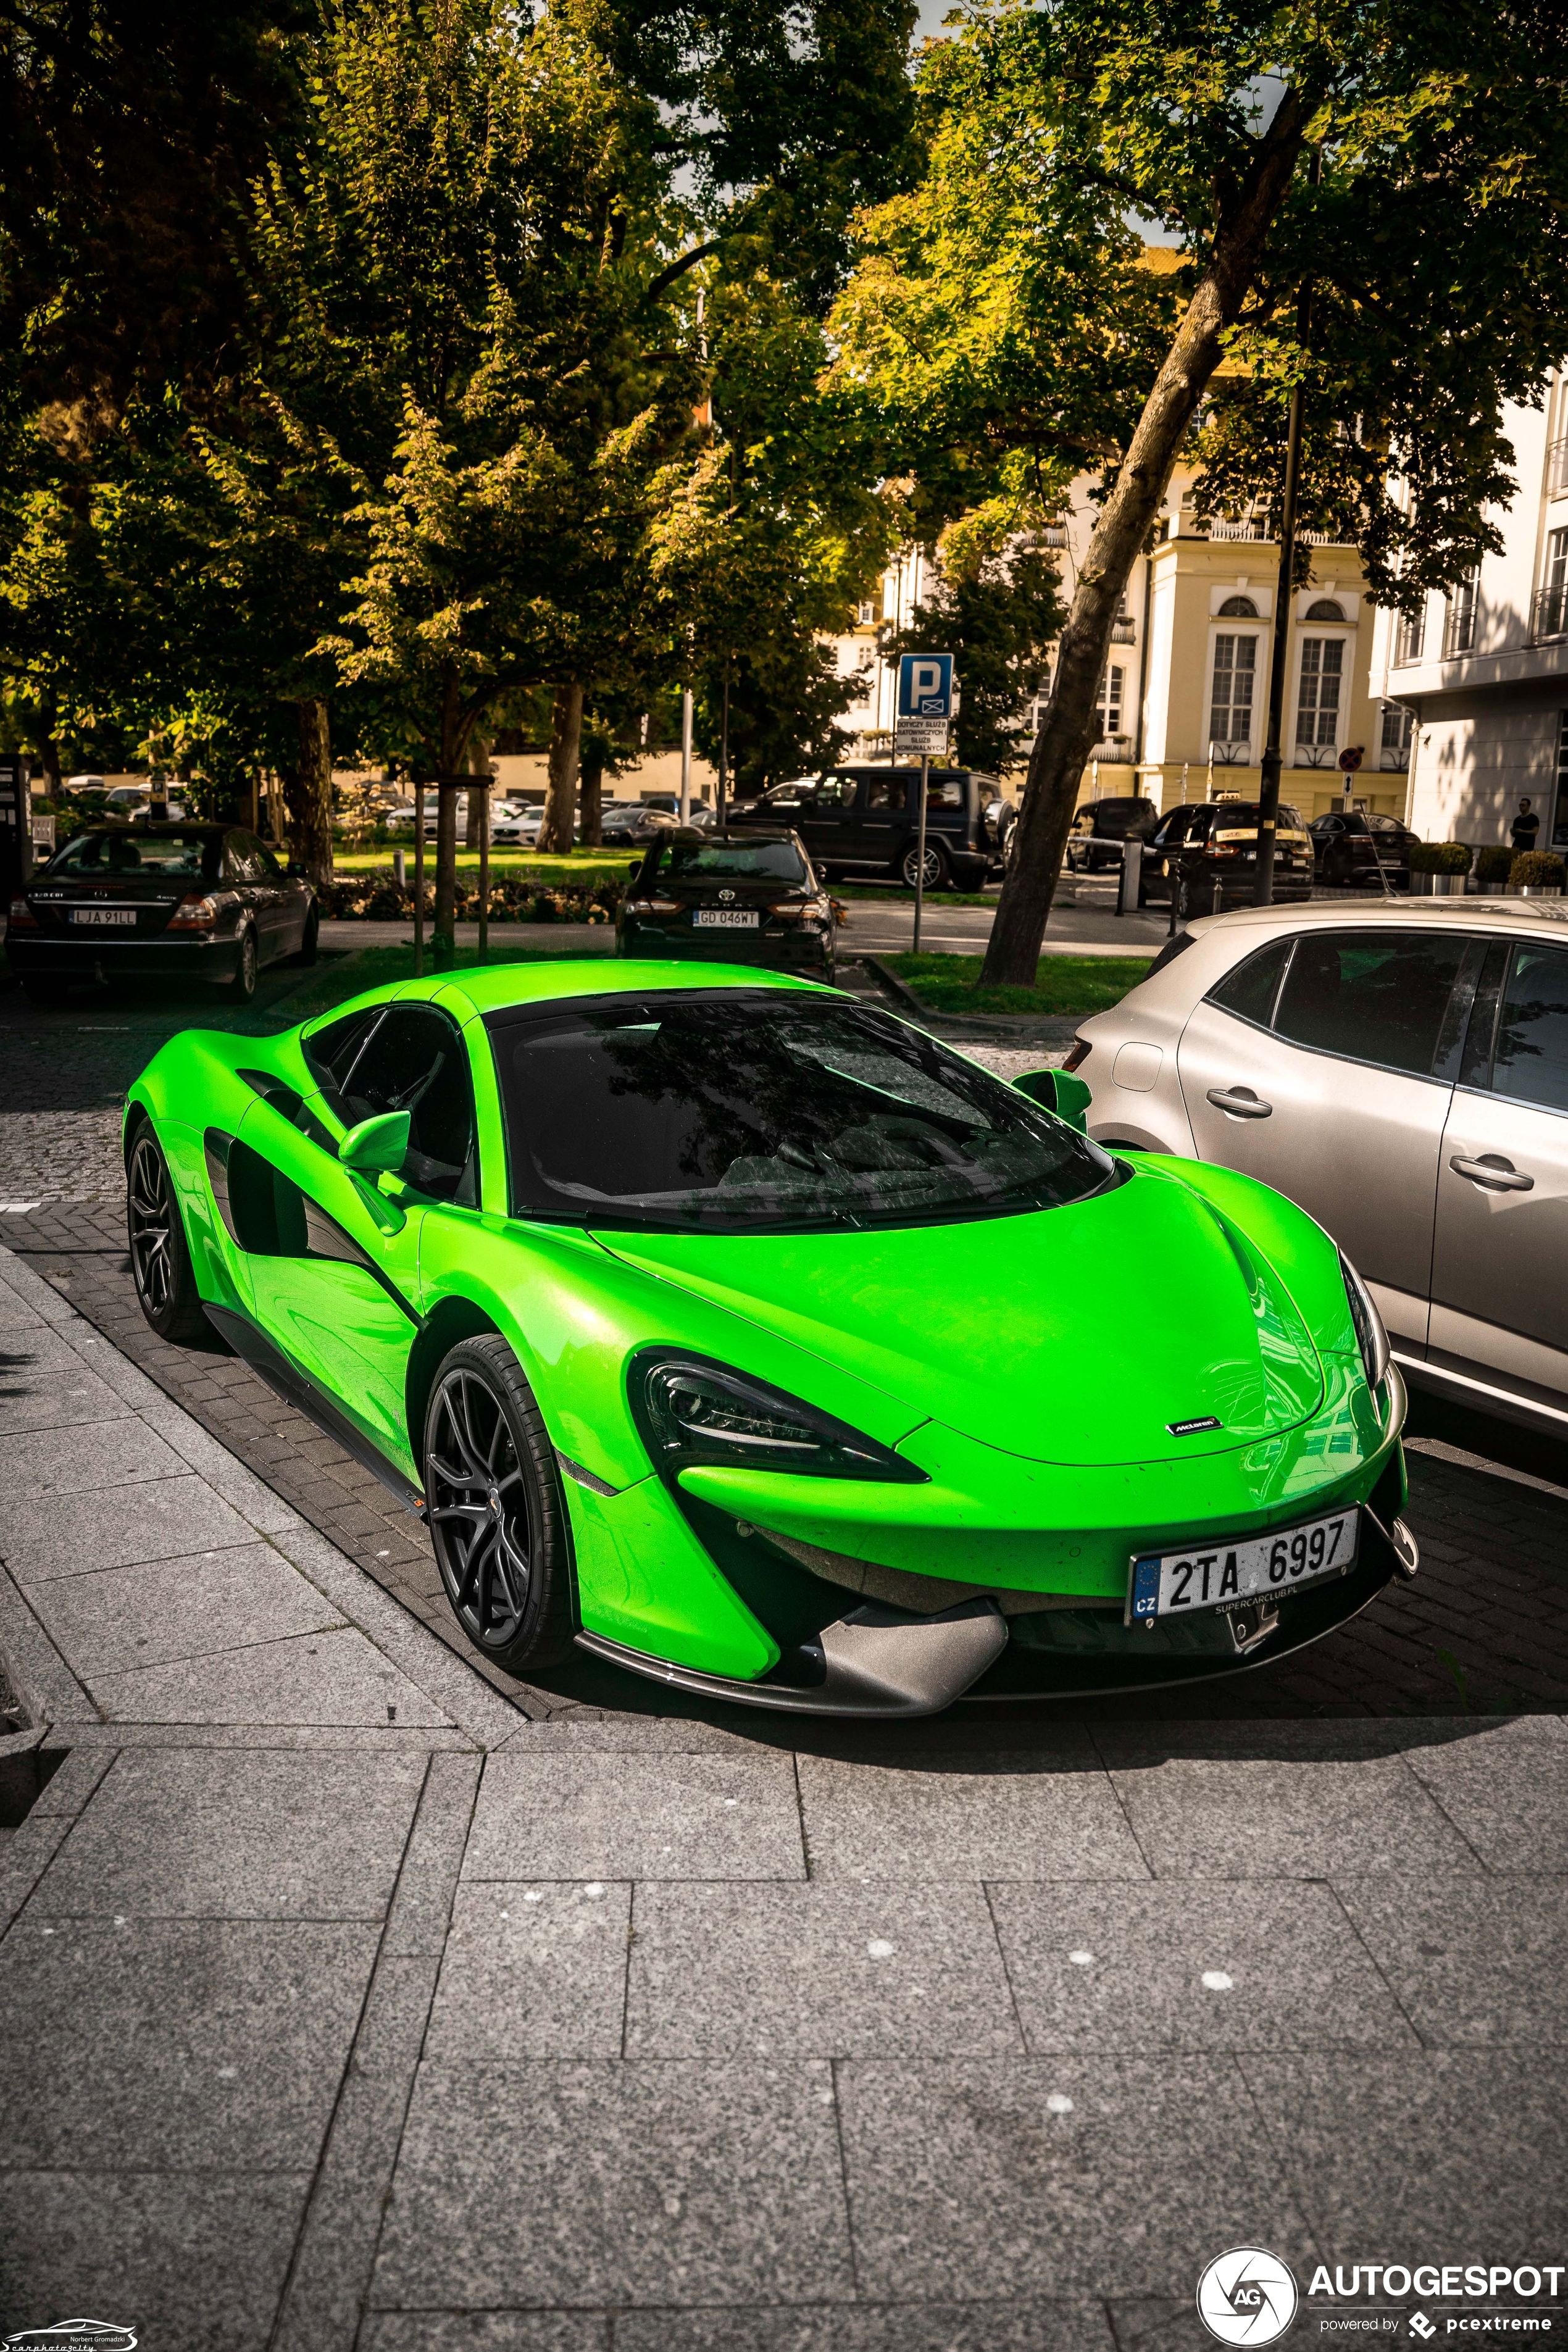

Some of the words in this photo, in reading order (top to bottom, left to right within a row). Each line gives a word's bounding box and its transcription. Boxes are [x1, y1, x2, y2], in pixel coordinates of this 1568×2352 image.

[911, 661, 941, 708] P
[77, 912, 101, 923] LJA
[106, 912, 133, 924] 91LL
[701, 912, 716, 923] GD
[720, 912, 756, 924] 046WT
[1176, 1420, 1214, 1432] McLaren
[405, 1490, 425, 1507] 570S
[1170, 1551, 1238, 1607] 2TA
[1269, 1519, 1345, 1583] 6997
[1136, 1598, 1156, 1612] CZ
